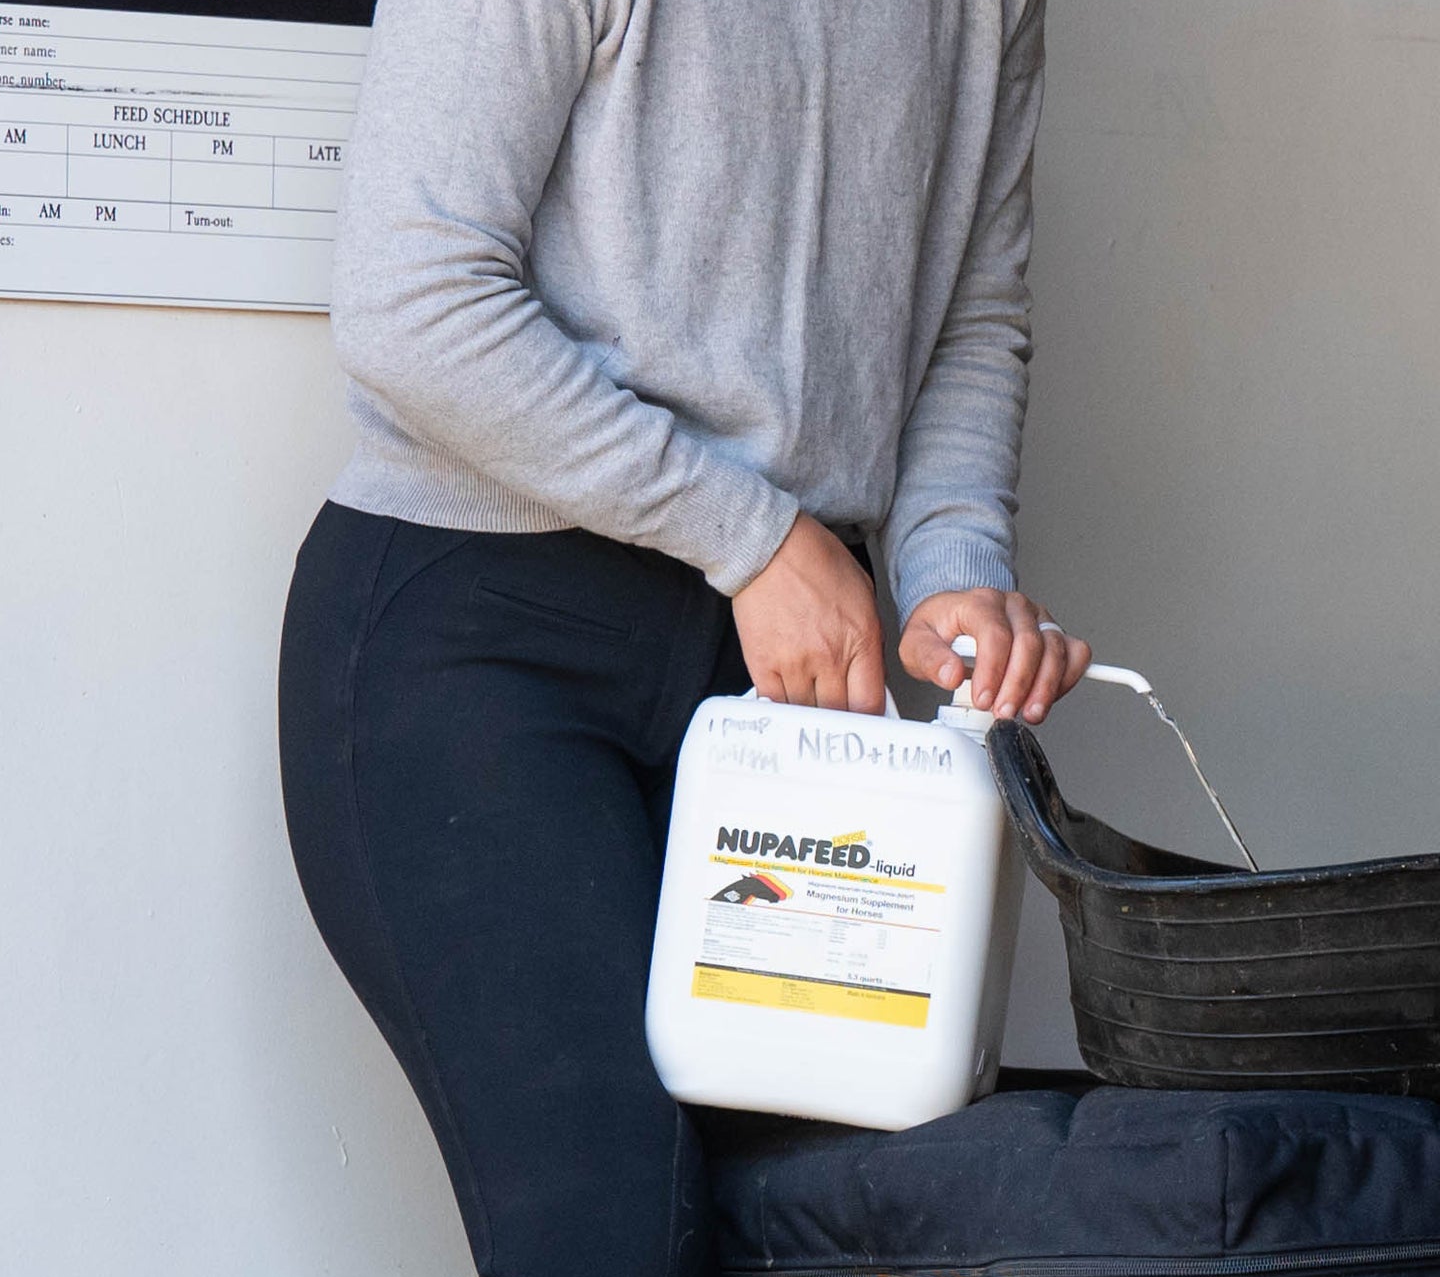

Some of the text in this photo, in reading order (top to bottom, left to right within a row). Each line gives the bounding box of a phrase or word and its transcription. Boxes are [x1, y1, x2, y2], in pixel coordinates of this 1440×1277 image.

[19, 16, 51, 29] name:
[23, 46, 57, 59] name:
[20, 76, 67, 91] number:
[113, 105, 231, 128] FEED SCHEDULE
[4, 128, 27, 145] AM
[93, 133, 147, 152] LUNCH
[212, 140, 234, 156] PM
[308, 144, 342, 162] LATE
[39, 203, 62, 220] AM
[95, 205, 117, 222] PM
[185, 211, 234, 229] Turn-out:
[716, 825, 871, 870] NUPAFEED
[806, 889, 859, 905] Magnesium
[860, 896, 914, 912] Supplement
[836, 905, 884, 919] for Horses
